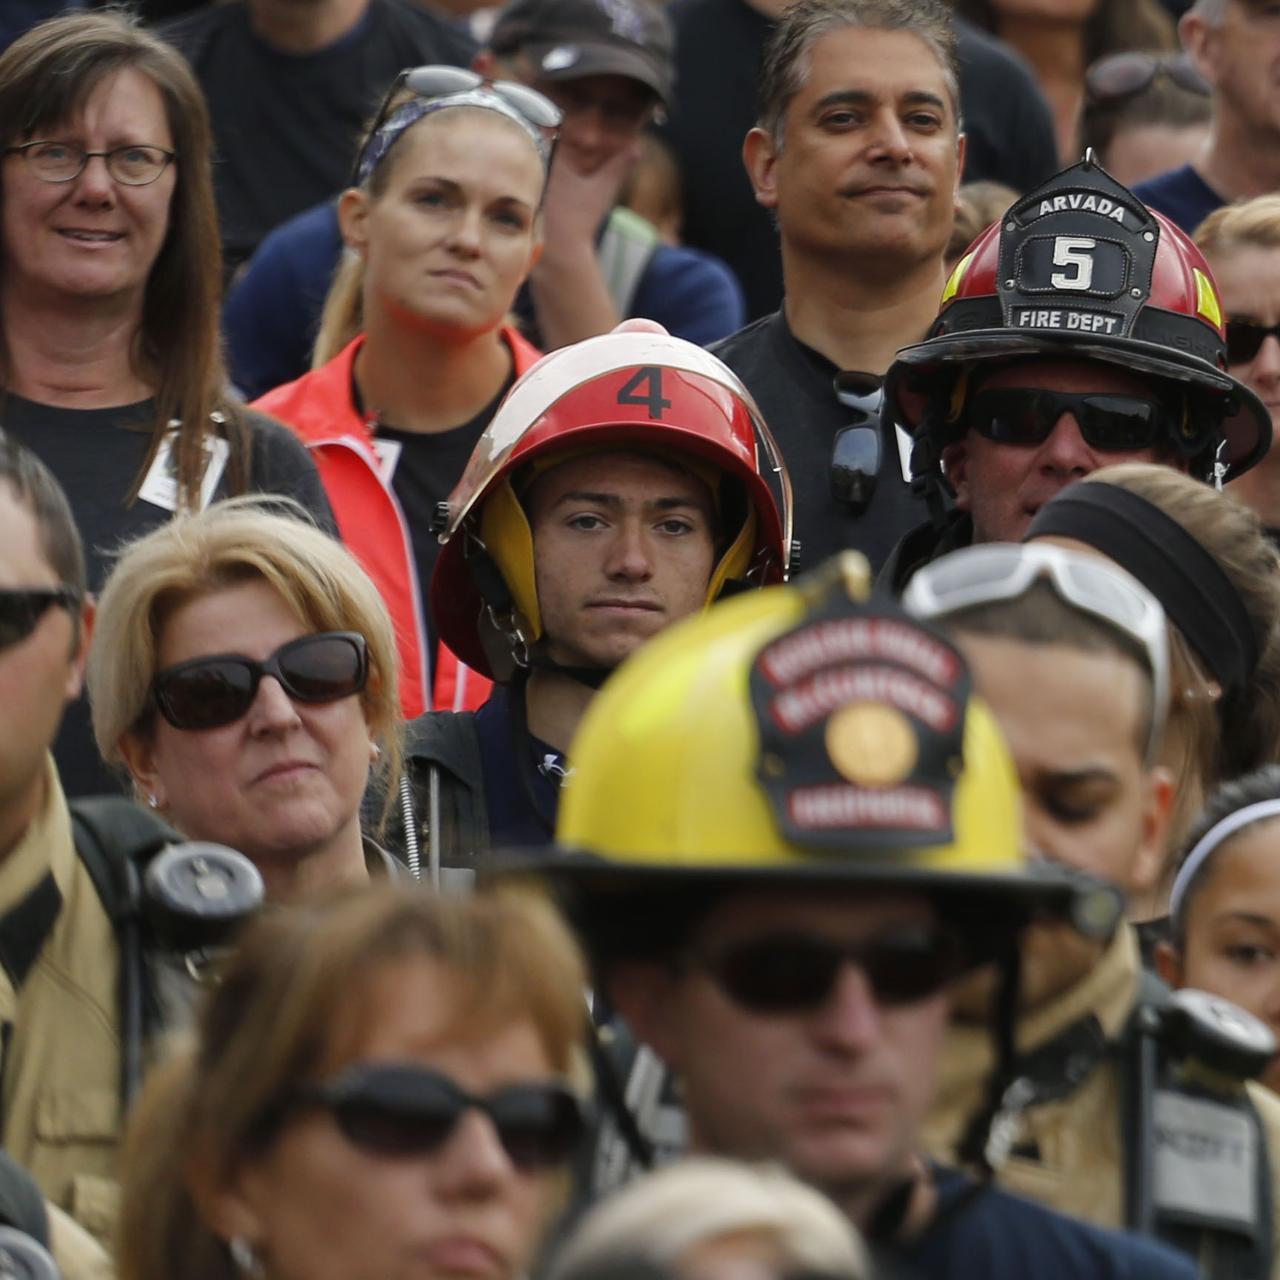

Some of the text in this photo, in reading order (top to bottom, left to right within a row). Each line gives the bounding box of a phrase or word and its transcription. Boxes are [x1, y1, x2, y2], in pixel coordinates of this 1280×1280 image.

[1039, 194, 1126, 223] ARVADA
[1051, 236, 1096, 290] 5
[1019, 311, 1117, 334] FIRE DEPT
[616, 367, 673, 420] 4
